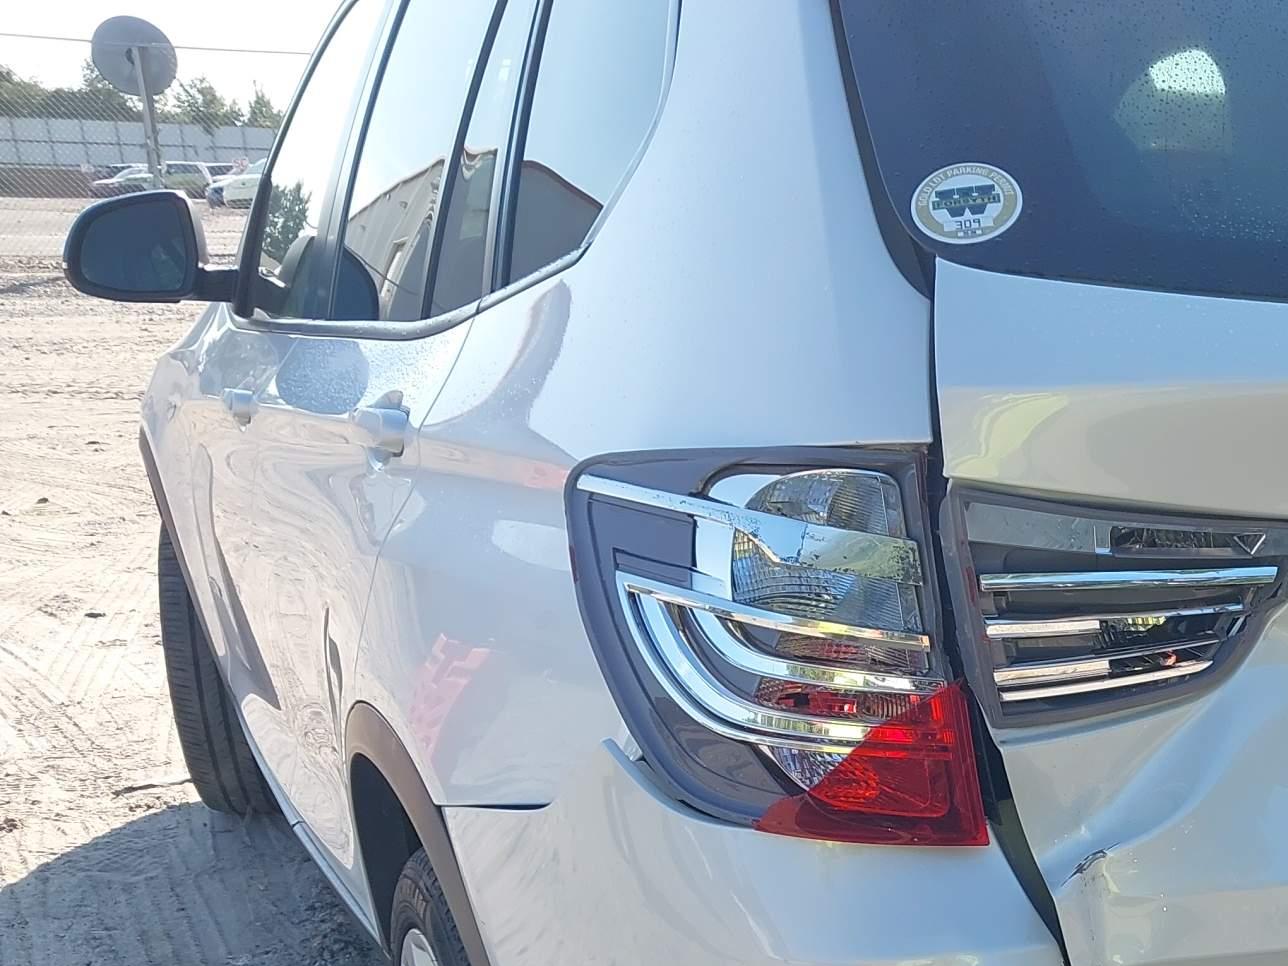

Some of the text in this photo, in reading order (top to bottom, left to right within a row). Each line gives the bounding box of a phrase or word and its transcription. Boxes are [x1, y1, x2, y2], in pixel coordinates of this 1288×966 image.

[946, 165, 989, 177] PARKING
[934, 194, 999, 209] FORSYTH
[955, 219, 982, 230] 309
